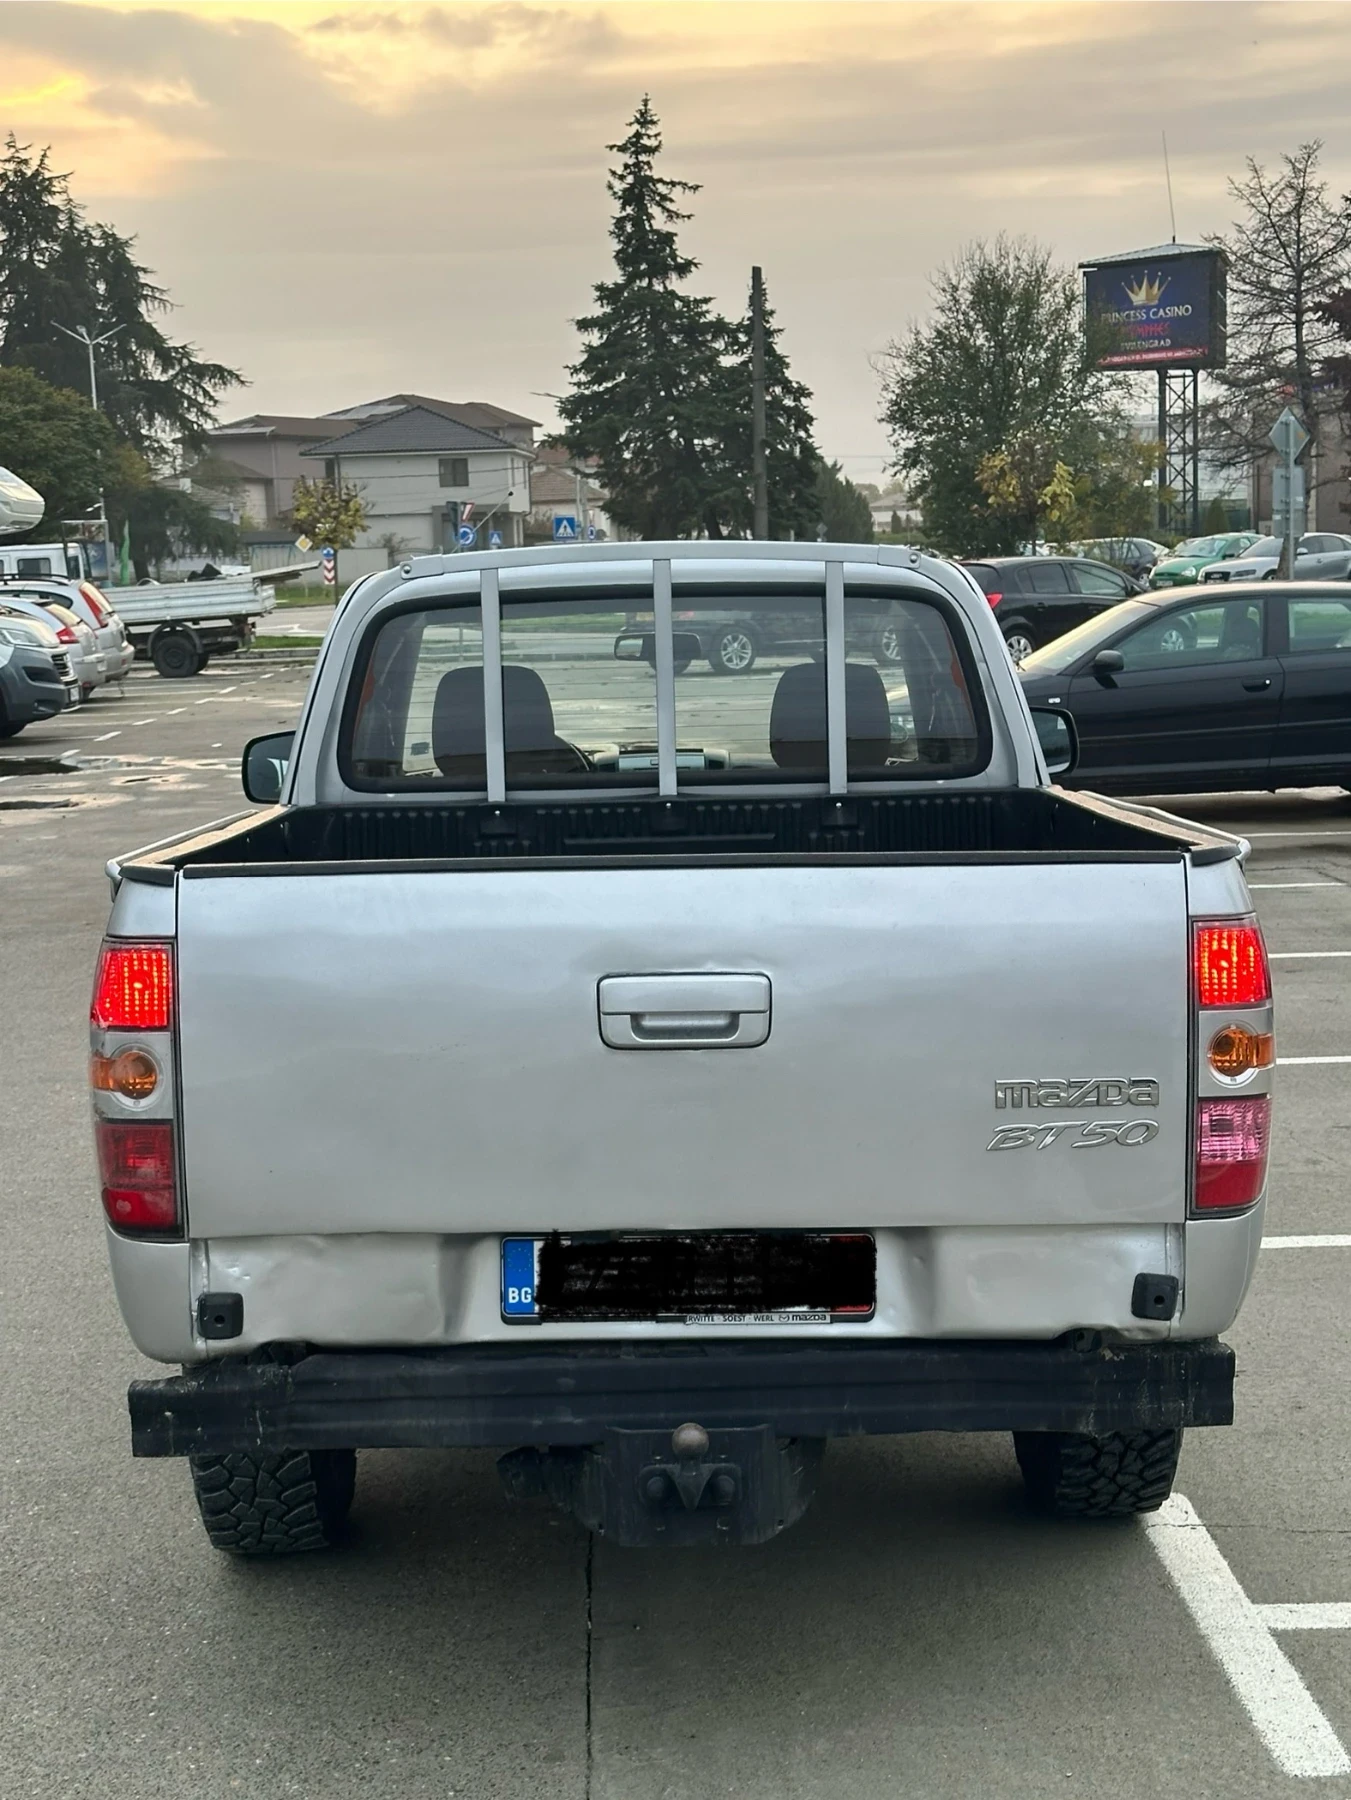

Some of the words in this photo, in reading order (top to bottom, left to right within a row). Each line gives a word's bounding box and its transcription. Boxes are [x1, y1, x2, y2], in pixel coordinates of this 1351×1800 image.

[1101, 310, 1147, 323] PRINCESS
[1149, 305, 1192, 319] CASINO
[508, 1287, 532, 1304] BG
[722, 1314, 746, 1323] SOEST
[753, 1313, 775, 1322] WERL
